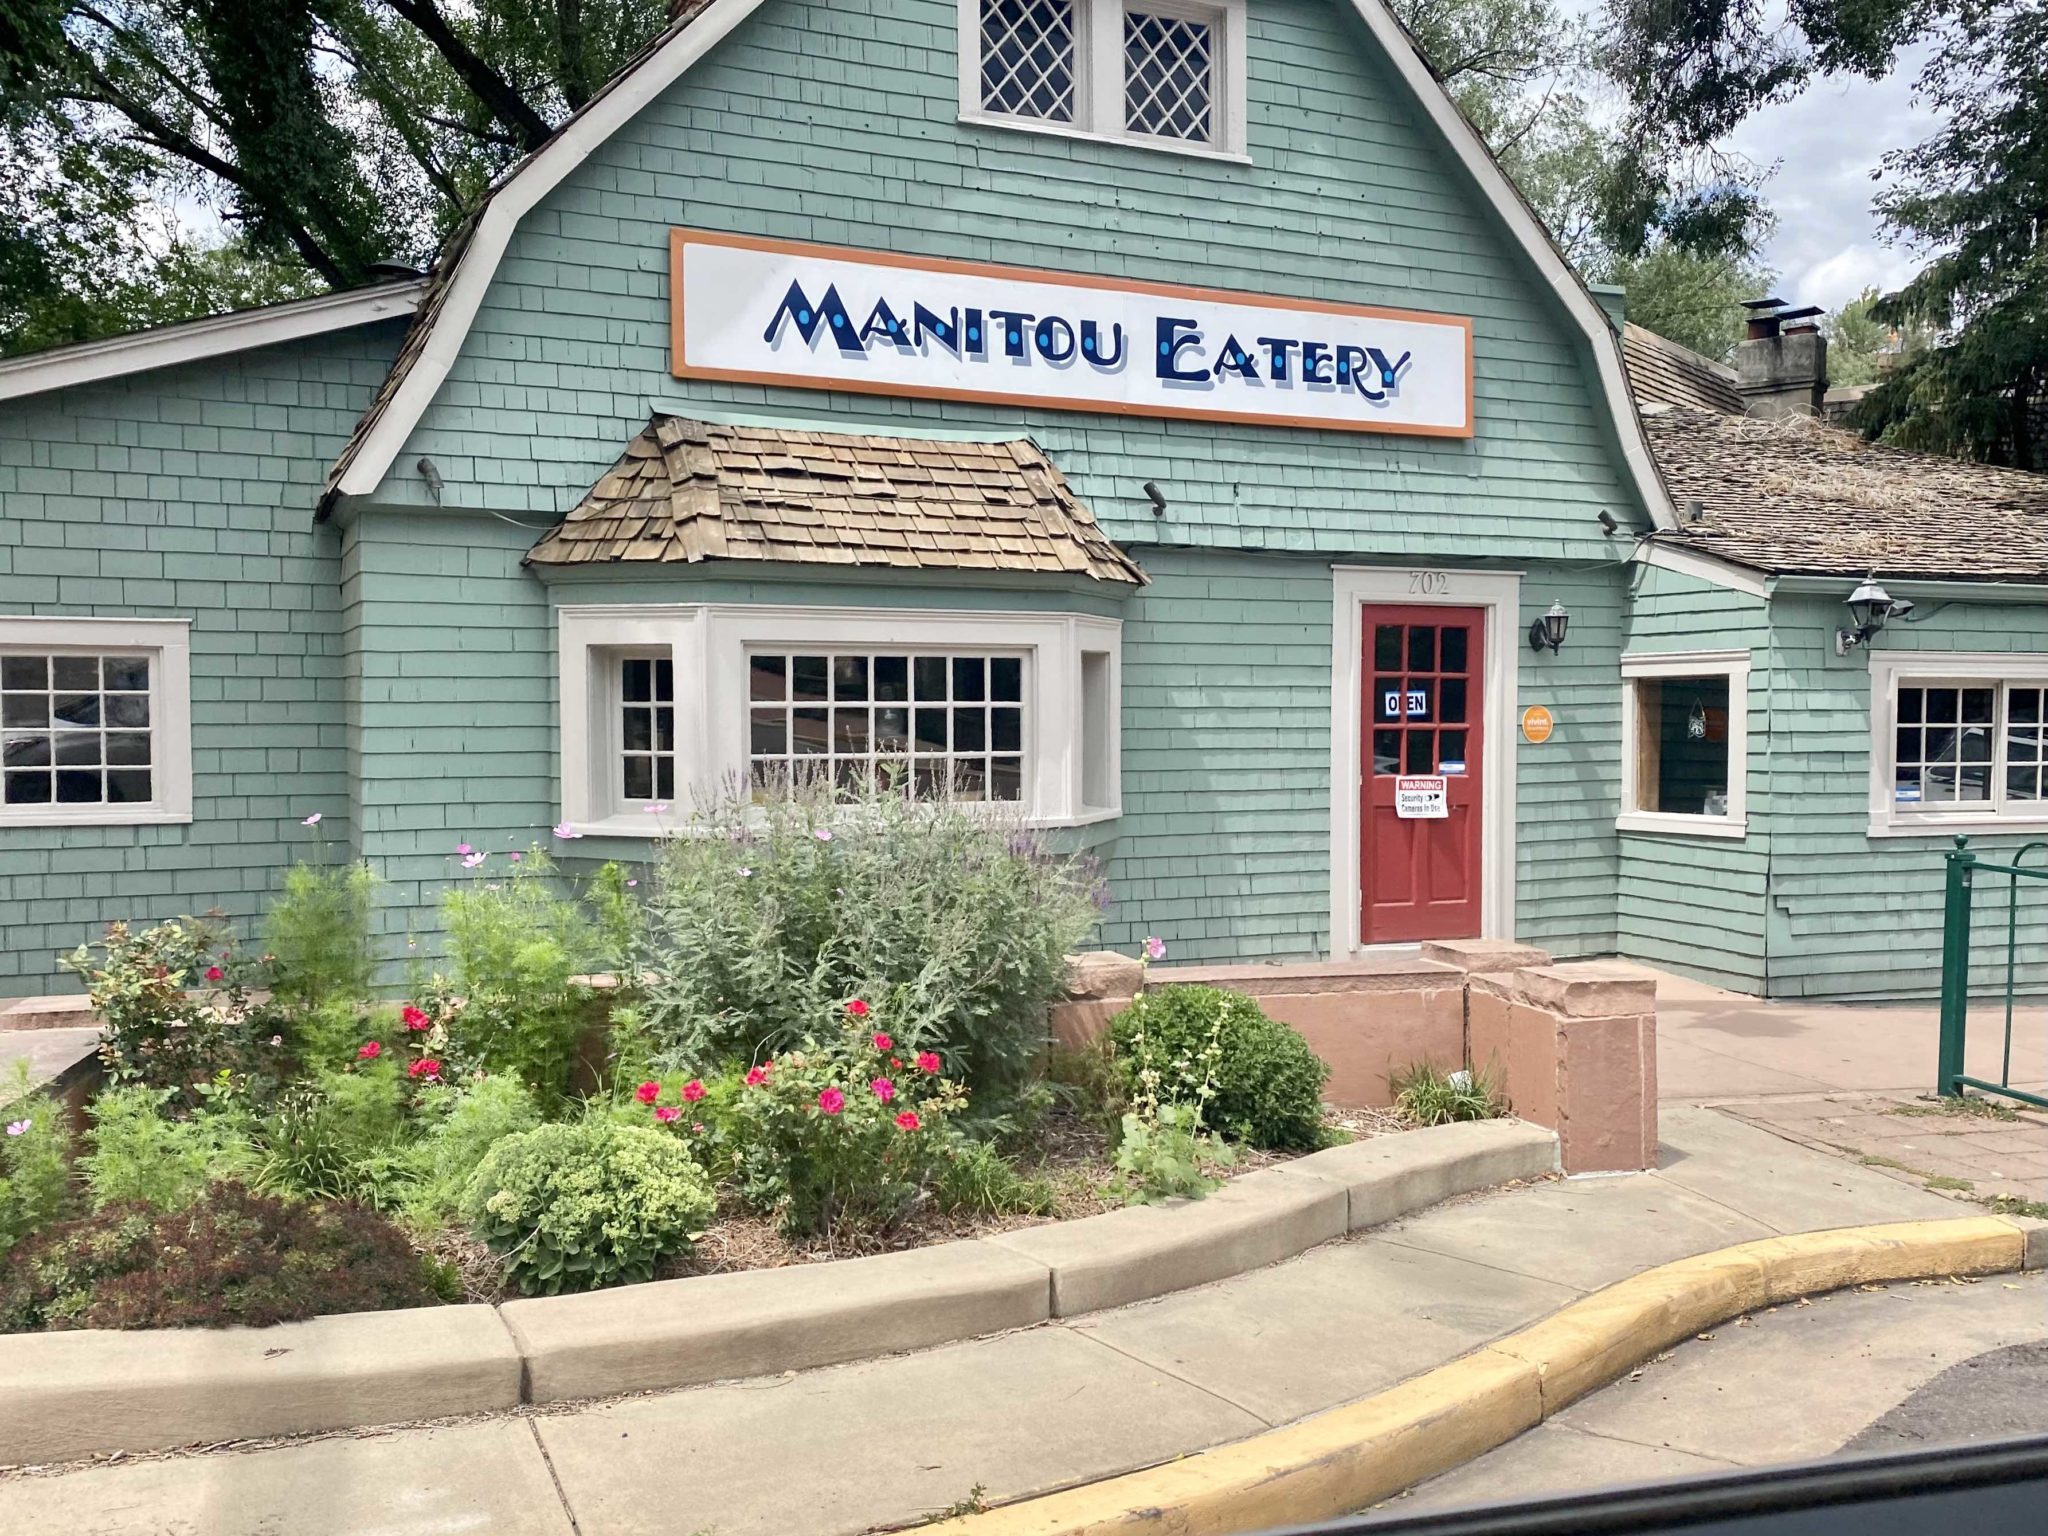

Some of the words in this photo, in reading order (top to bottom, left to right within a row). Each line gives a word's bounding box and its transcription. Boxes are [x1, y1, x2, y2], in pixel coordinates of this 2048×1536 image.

[763, 278, 1123, 368] MANITOU
[1155, 317, 1412, 401] EATERY
[1409, 571, 1449, 595] 702
[1388, 695, 1424, 711] OEN
[1400, 780, 1442, 790] WARNING
[1401, 793, 1423, 803] Security
